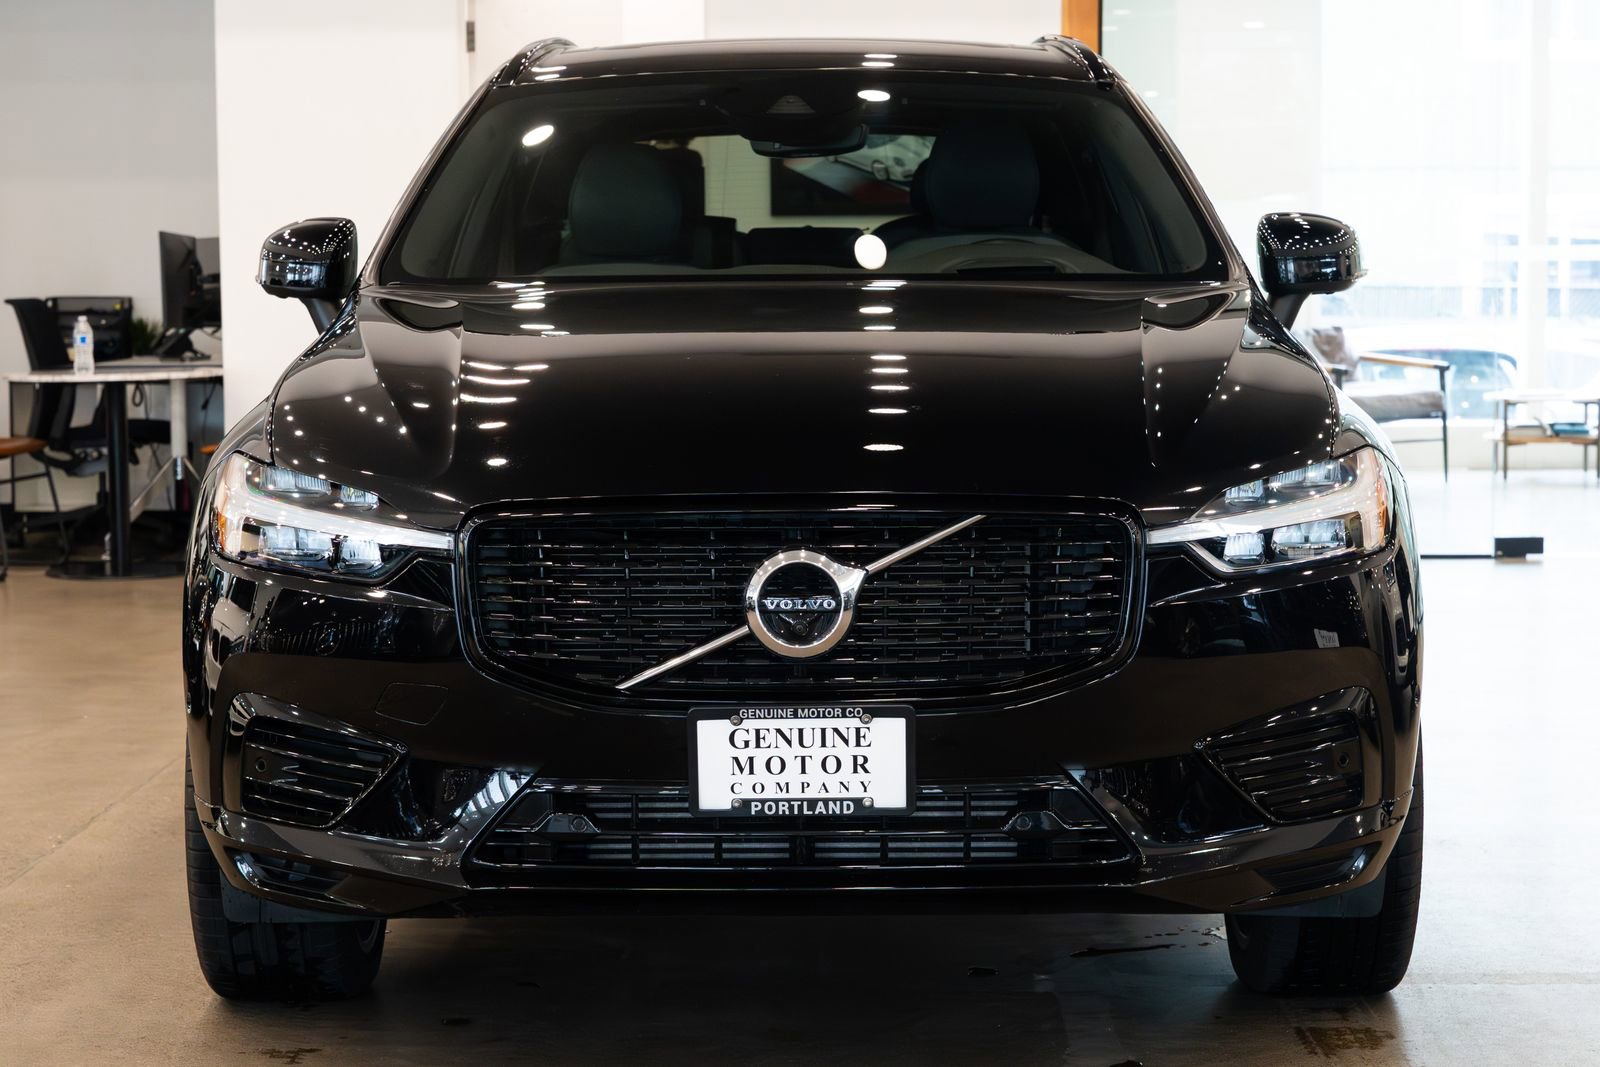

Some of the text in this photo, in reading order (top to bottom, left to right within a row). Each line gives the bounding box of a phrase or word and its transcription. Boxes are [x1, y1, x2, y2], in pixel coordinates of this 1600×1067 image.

[762, 599, 836, 610] VOLVO
[739, 707, 863, 719] GENUINE MOTOR CO
[728, 726, 872, 750] GENUINE
[730, 754, 871, 776] MOTOR
[730, 780, 872, 795] COMPANY
[750, 801, 855, 815] PORTLAND
